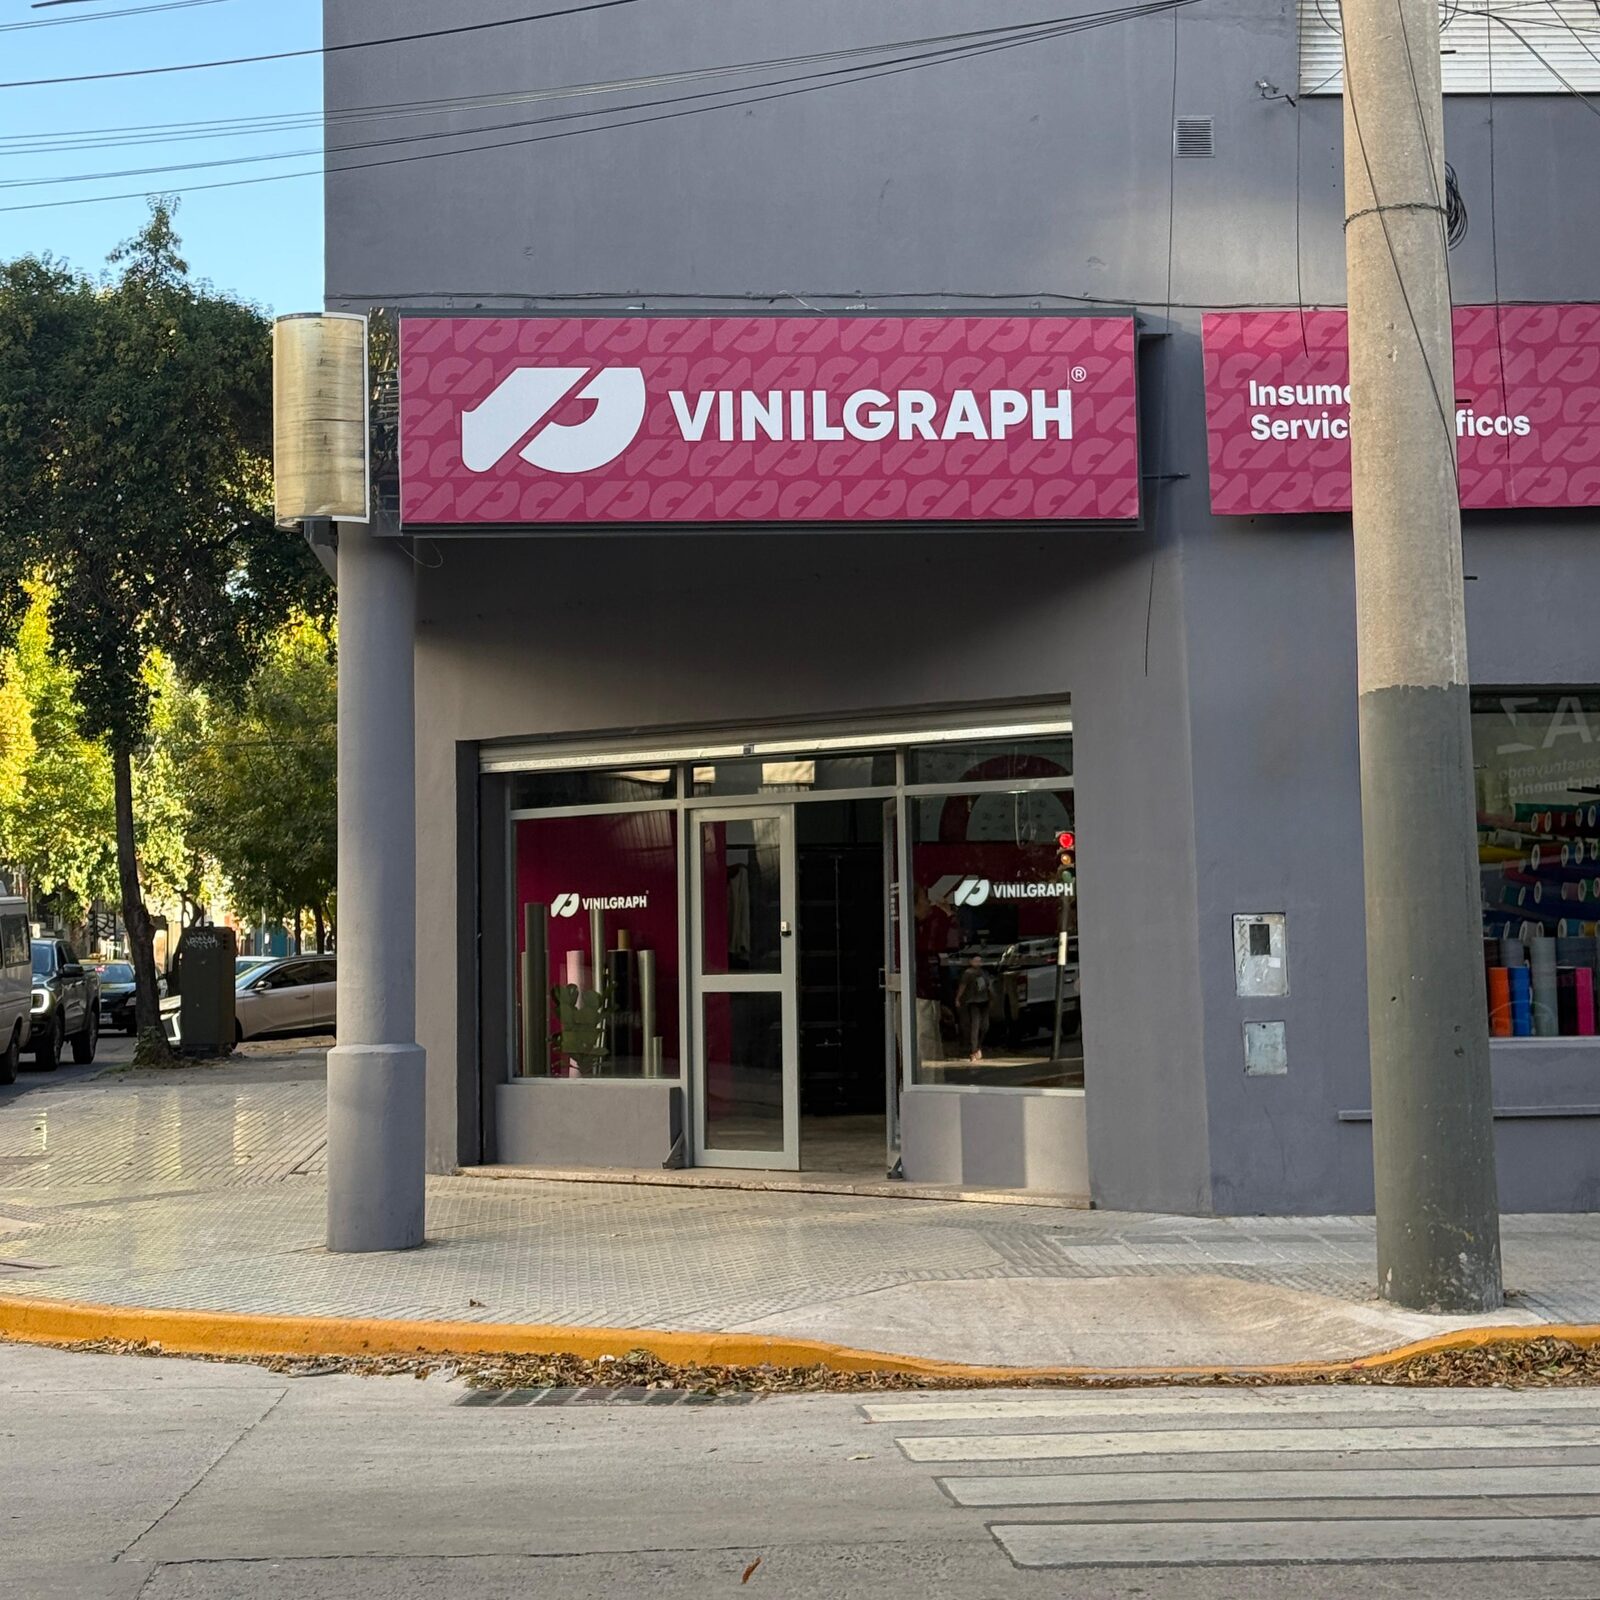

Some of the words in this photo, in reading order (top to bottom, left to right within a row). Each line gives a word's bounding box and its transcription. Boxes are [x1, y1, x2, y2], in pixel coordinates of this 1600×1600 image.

[1251, 411, 1351, 441] Servic
[1456, 408, 1531, 437] ficos
[993, 882, 1074, 899] VINILGRAPH
[581, 894, 648, 910] VINILGRAPH
